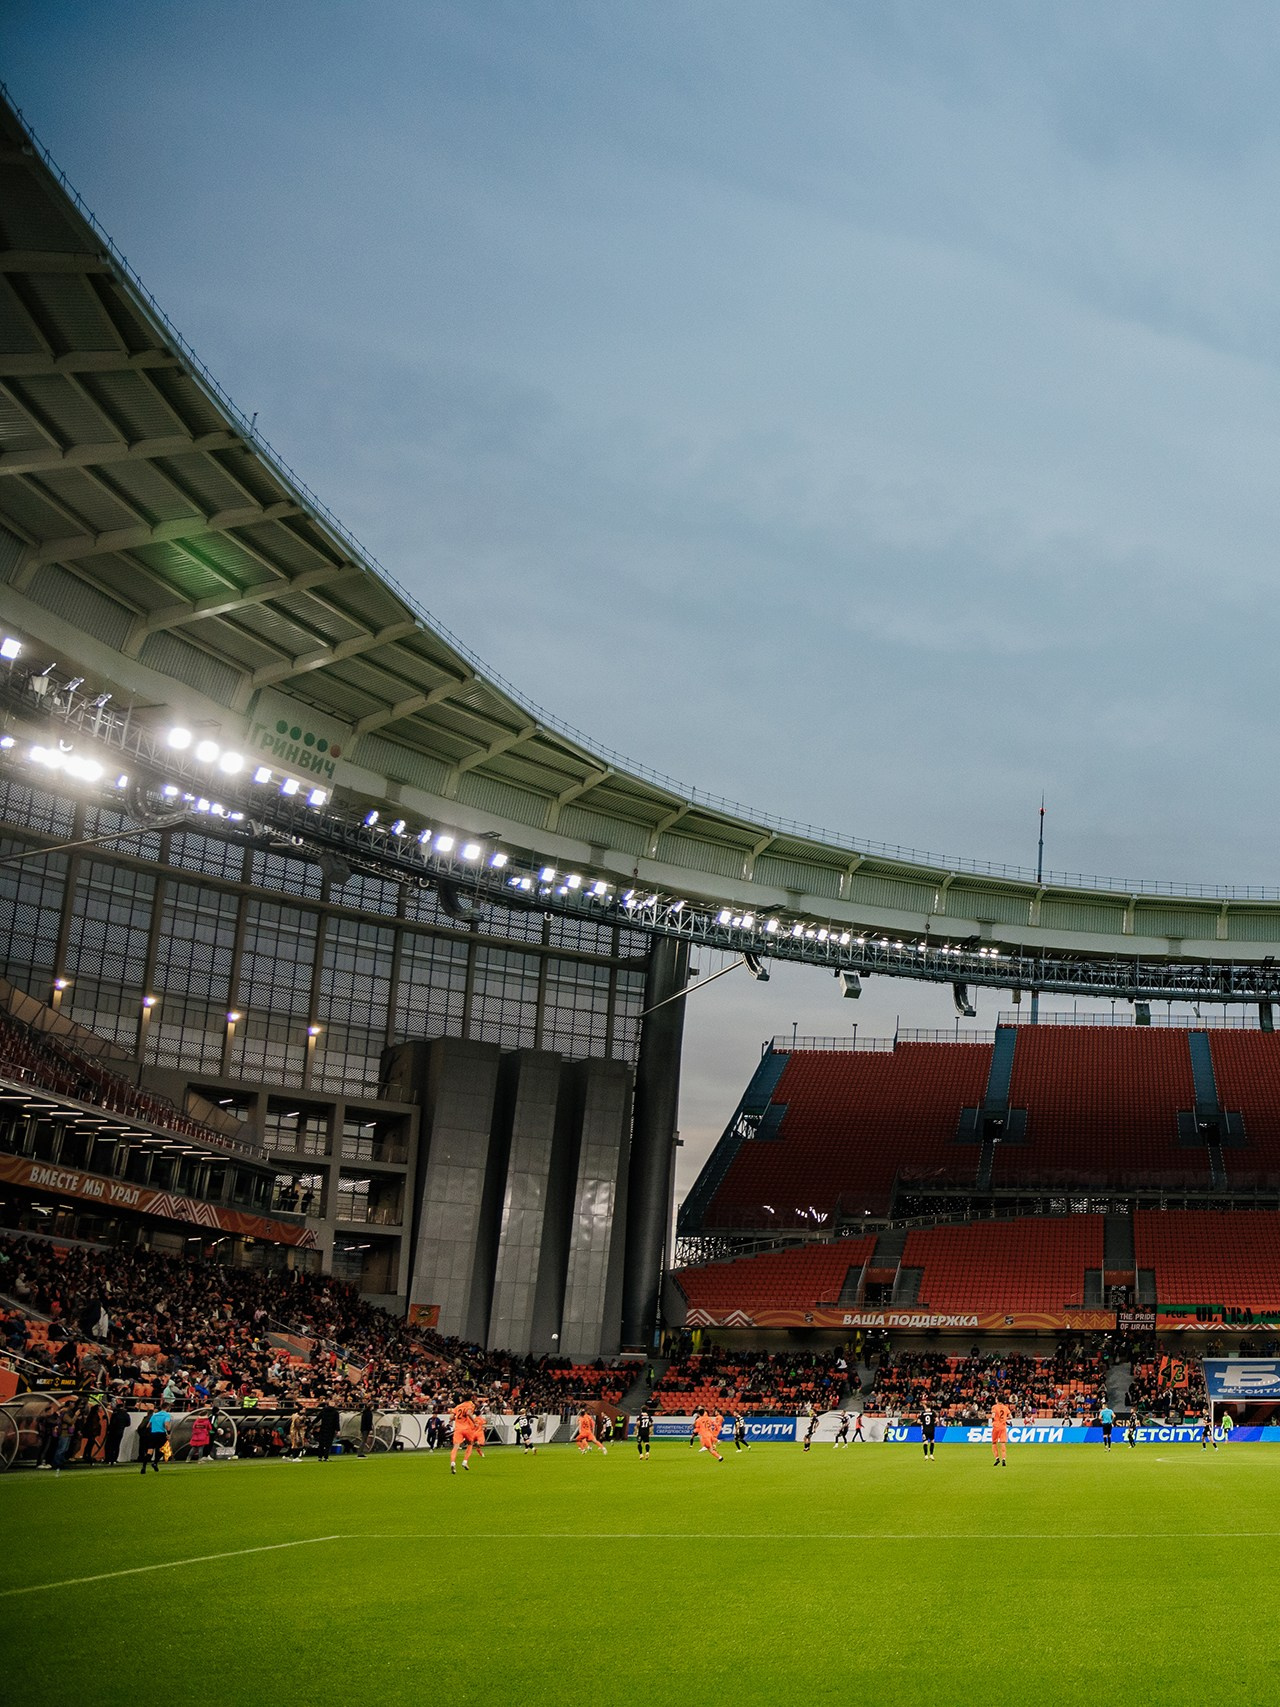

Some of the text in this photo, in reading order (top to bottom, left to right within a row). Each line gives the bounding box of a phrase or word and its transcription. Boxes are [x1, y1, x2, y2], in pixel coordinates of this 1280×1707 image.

[252, 722, 337, 779] ГРИНВИЧ
[29, 1166, 140, 1205] ВМЕСТЕ МЫ УРАЛ
[843, 1314, 979, 1327] ВАША ПОДДЕРЖКА
[1165, 1310, 1188, 1318] FCUE
[1196, 1306, 1254, 1324] ULTRA
[925, 1415, 931, 1425] 9
[1000, 1409, 1005, 1419] 2
[641, 1419, 649, 1428] 17
[721, 1424, 794, 1435] БТСИТИ
[966, 1428, 1064, 1442] БЕСИТИ
[1122, 1428, 1225, 1441] BETCITY.U
